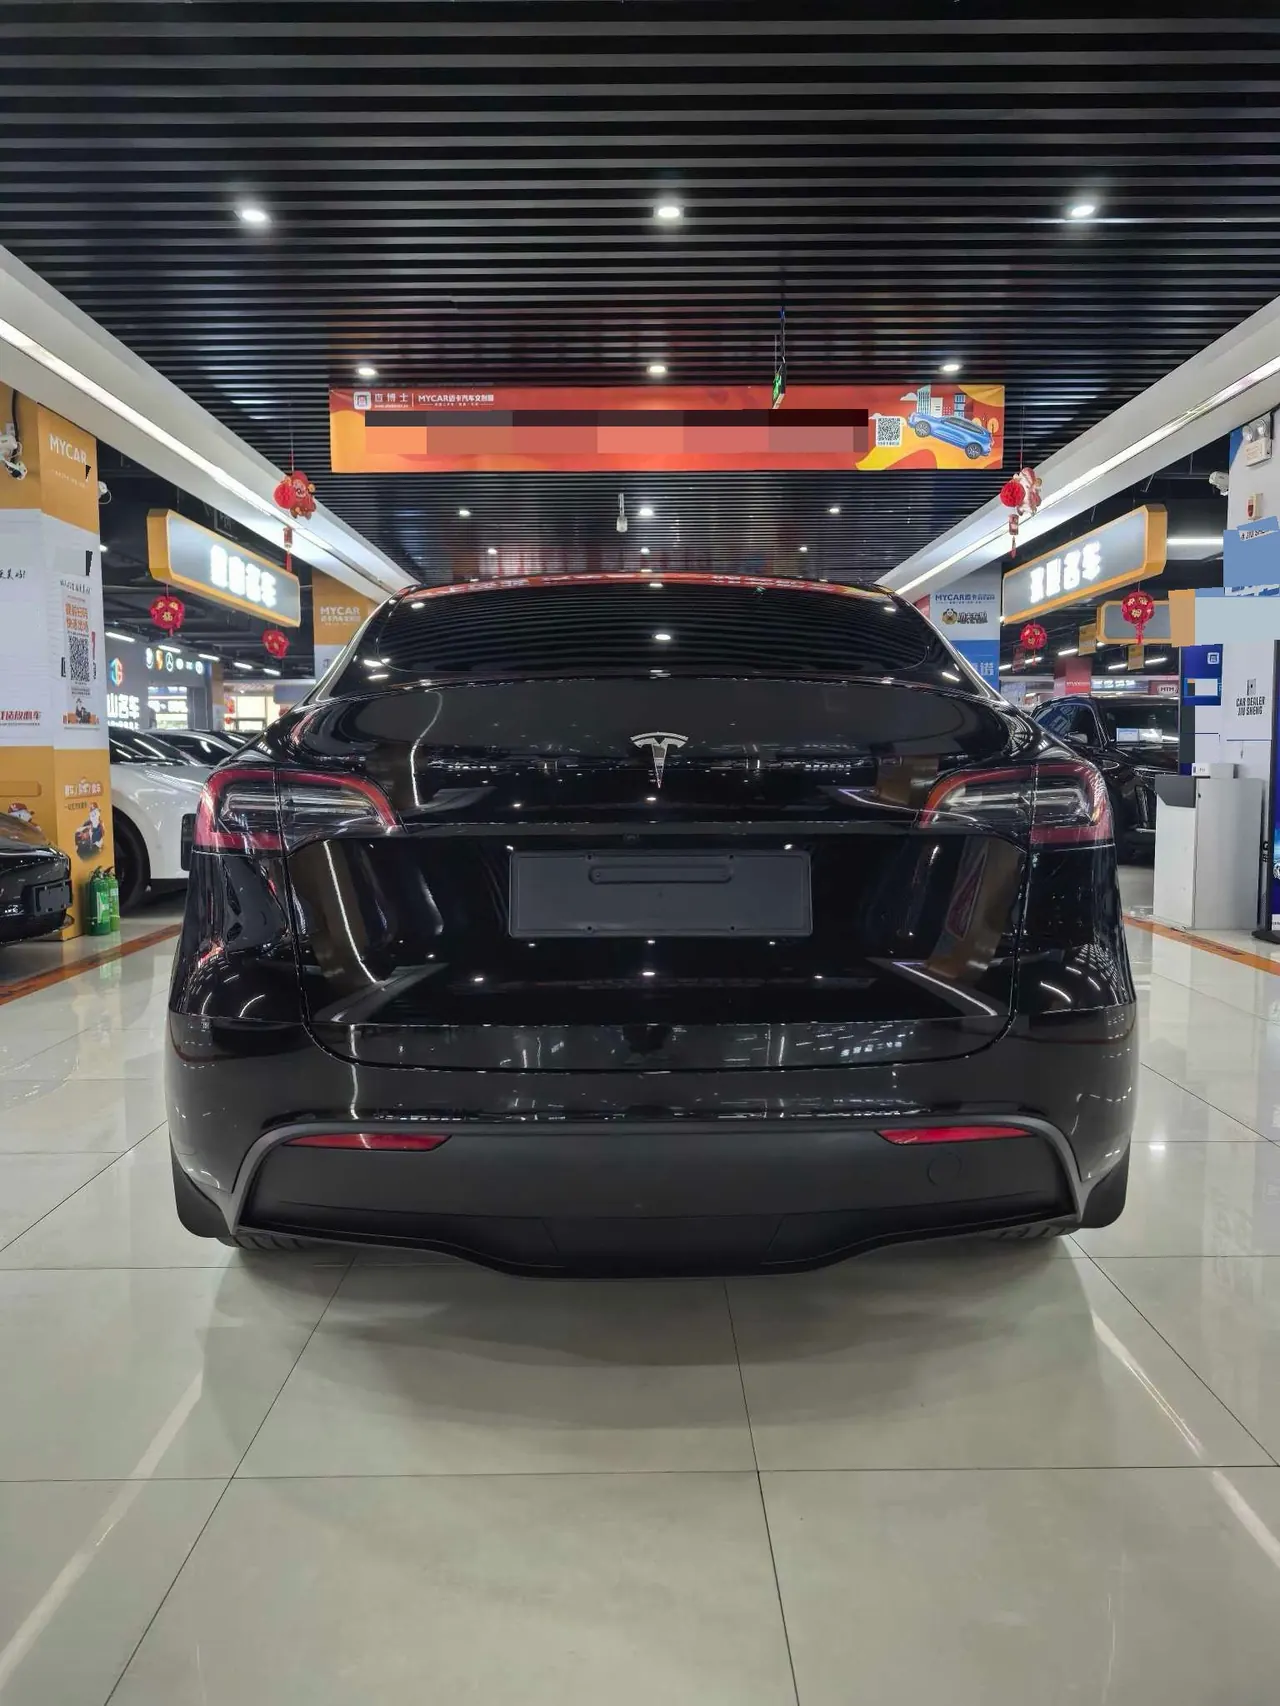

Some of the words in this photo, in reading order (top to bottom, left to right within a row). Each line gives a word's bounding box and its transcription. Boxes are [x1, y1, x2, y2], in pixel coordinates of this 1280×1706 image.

[49, 434, 87, 465] MYCAR
[320, 606, 360, 615] MYCAR
[1236, 698, 1246, 707] CAR
[1247, 696, 1265, 706] DEALER
[1246, 706, 1263, 715] SHENG
